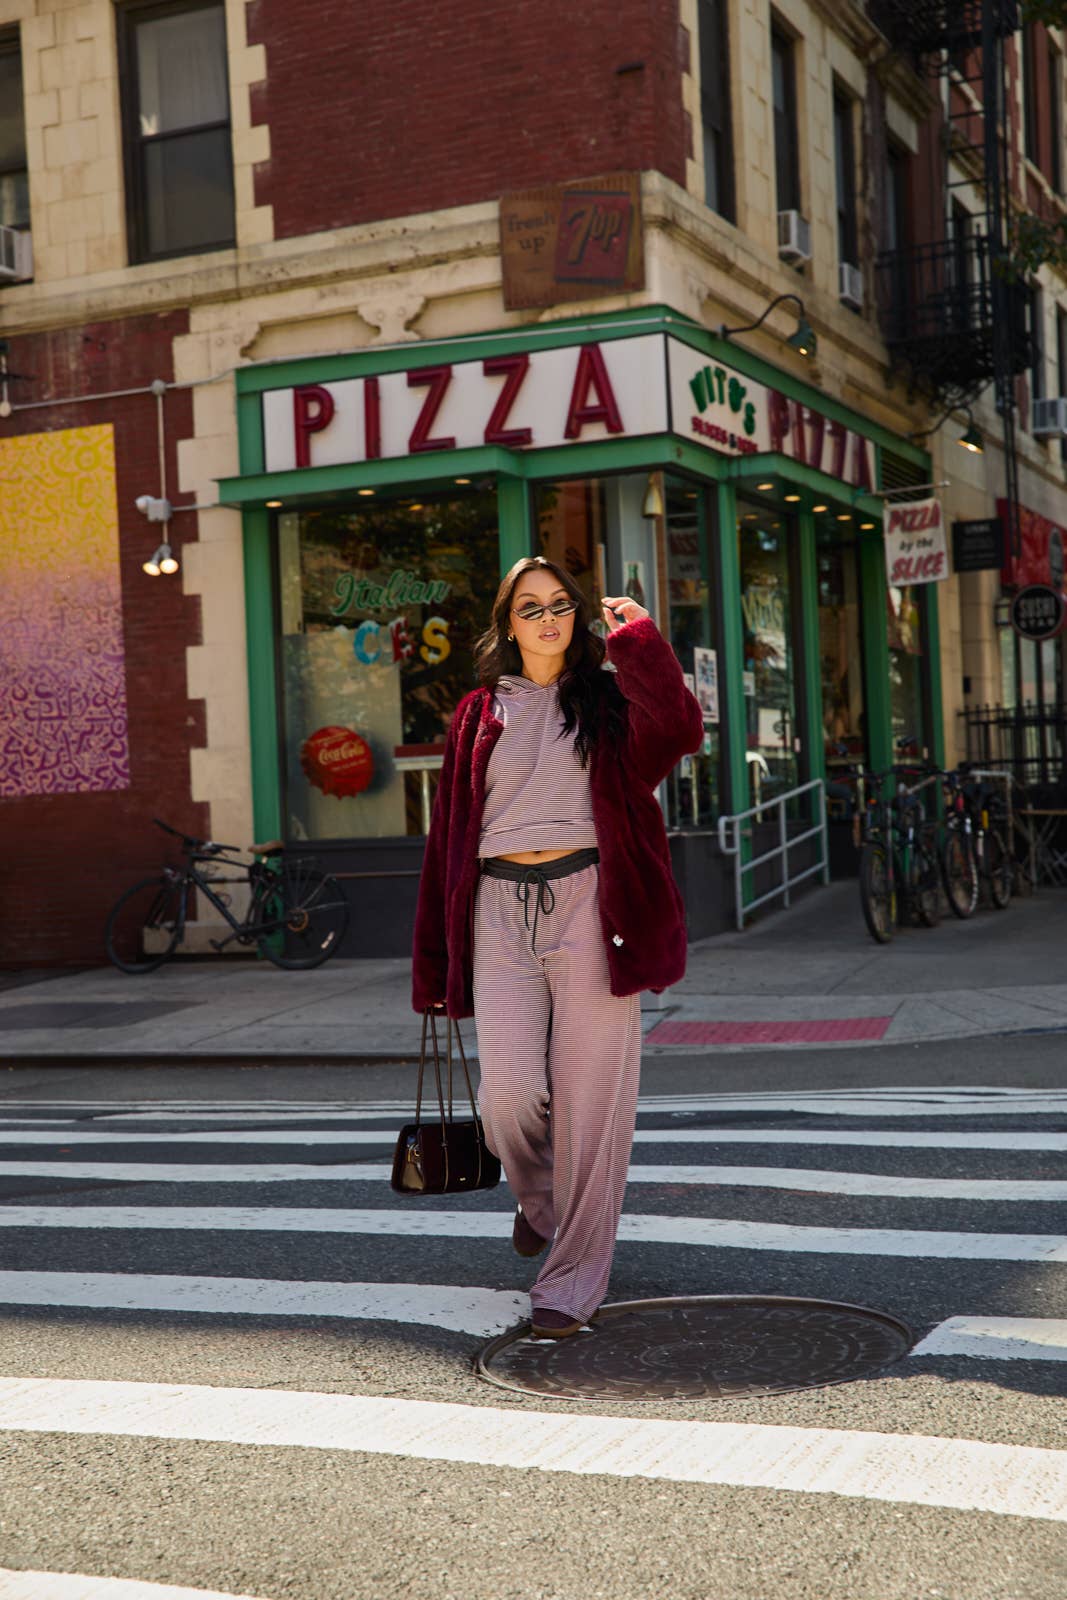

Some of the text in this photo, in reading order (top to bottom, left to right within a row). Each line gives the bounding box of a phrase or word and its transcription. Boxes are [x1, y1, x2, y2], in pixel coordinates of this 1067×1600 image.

[293, 342, 625, 468] PIZZA
[767, 388, 874, 495] PIZZA
[887, 502, 941, 535] PIZZA
[900, 536, 935, 555] by the
[891, 551, 945, 582] SLICE
[330, 569, 453, 617] Italian
